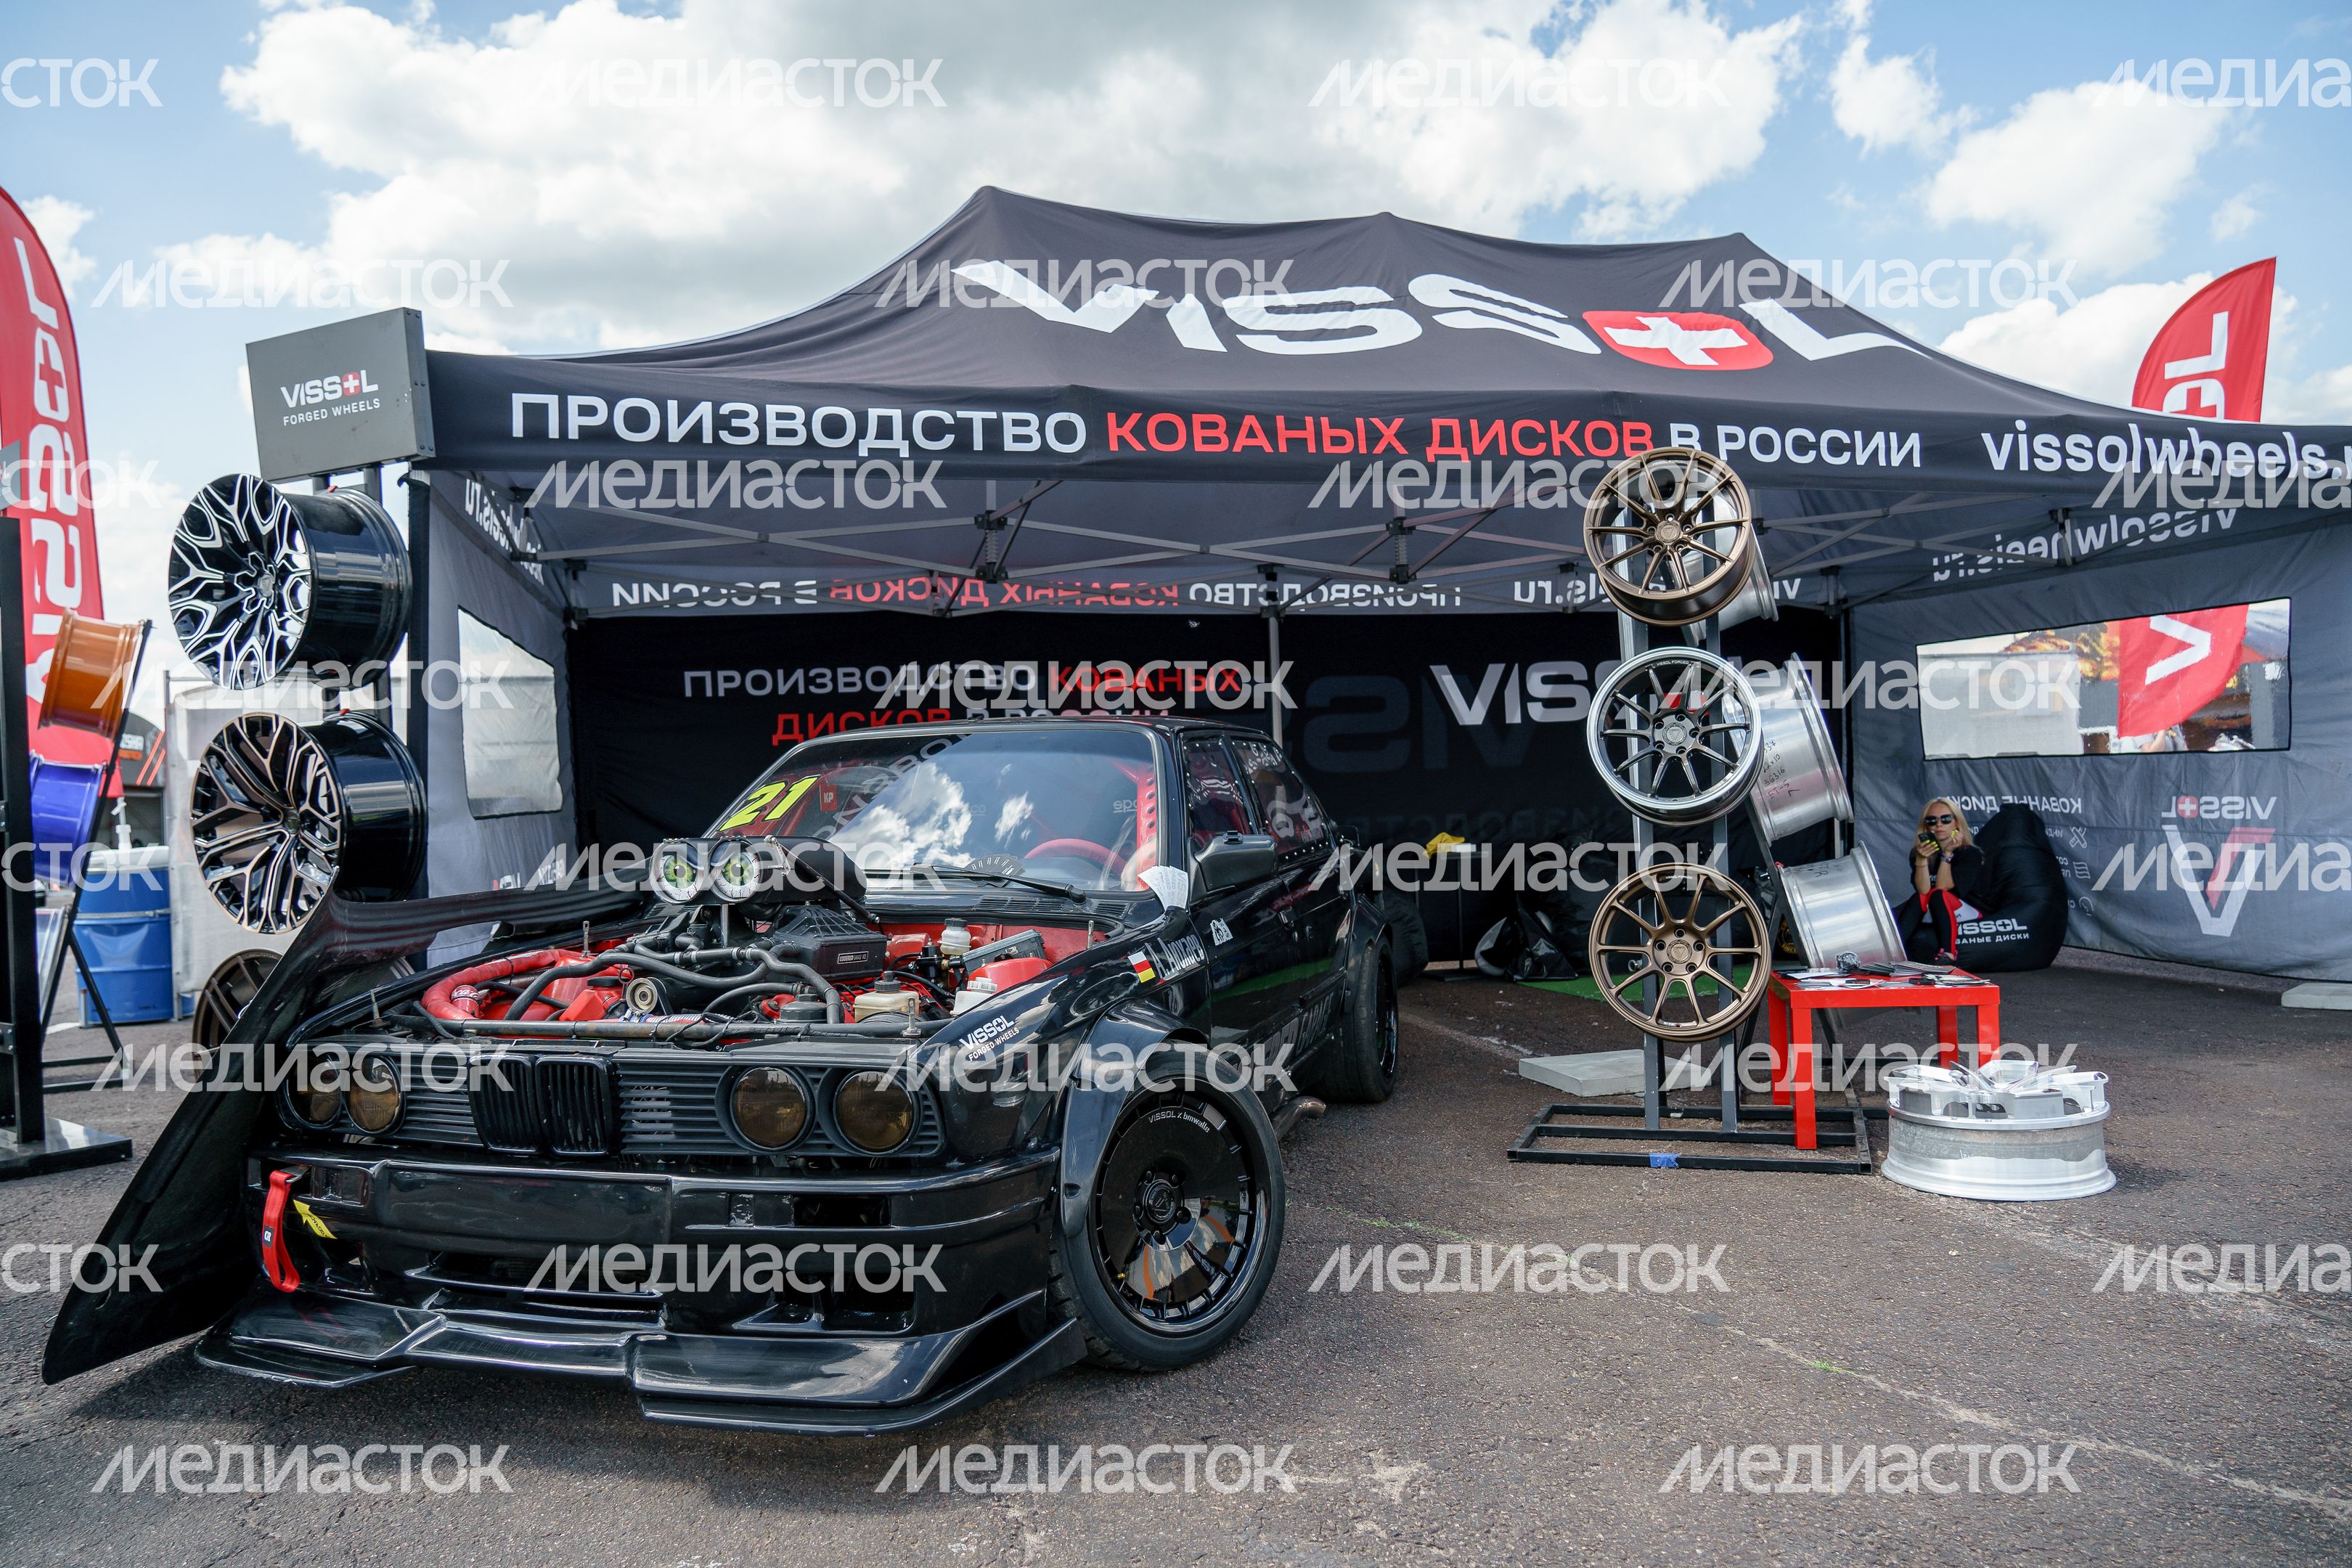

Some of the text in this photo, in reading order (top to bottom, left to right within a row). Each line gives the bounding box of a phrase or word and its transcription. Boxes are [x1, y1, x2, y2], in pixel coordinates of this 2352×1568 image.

[283, 398, 380, 426] FORGED WHEELS
[510, 393, 1087, 458] ПРОИЗВОДСТВО
[1107, 412, 1403, 456] КОВАНЫХ
[1426, 417, 1654, 463] ДИСКОВ
[1717, 425, 1922, 468] РОССИИ
[684, 664, 1242, 698] ПРОИЗВОДСТВО КОВАНЫХ
[719, 774, 821, 833] 21
[1955, 933, 2030, 945] ВАНЫЕ ДИСКИ
[1956, 918, 2028, 936] ISSOL
[958, 1015, 1015, 1050] VISSOL
[968, 1026, 1020, 1062] FORGED WHEELS
[1148, 1110, 1177, 1124] VISSOL
